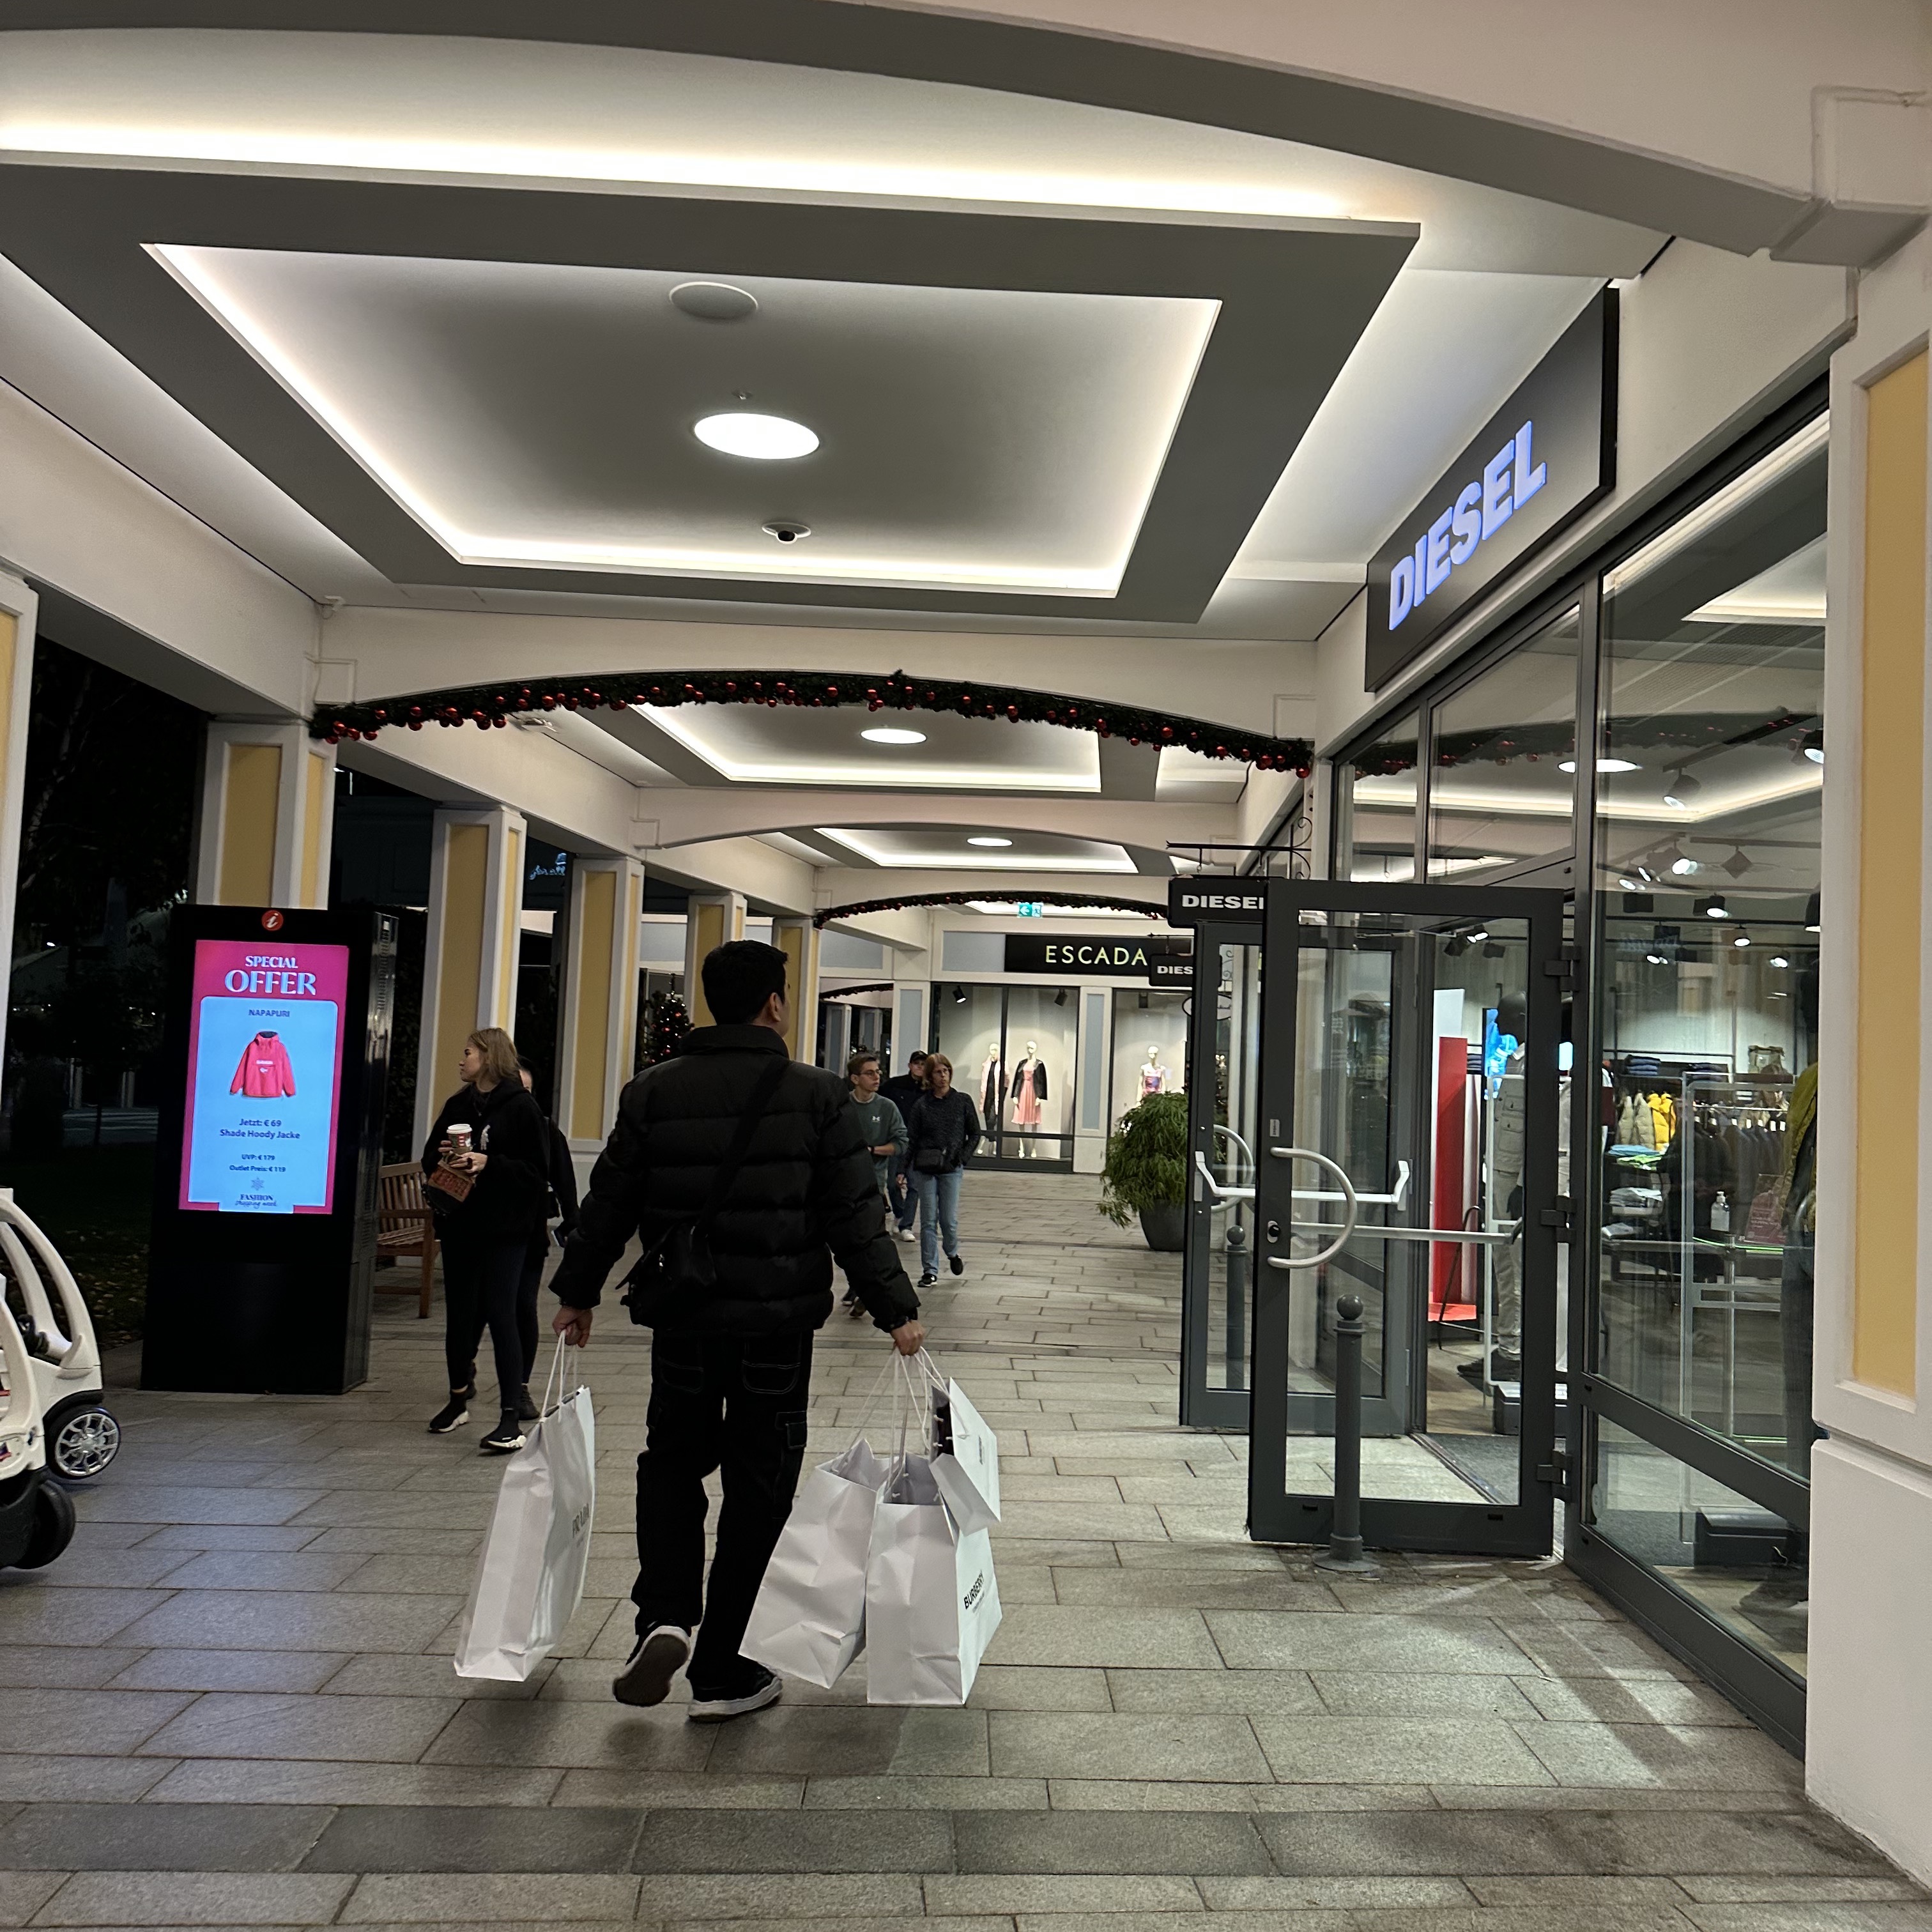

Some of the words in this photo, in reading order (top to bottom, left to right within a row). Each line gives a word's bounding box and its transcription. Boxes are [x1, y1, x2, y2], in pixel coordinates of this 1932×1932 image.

[1388, 420, 1547, 631] DIESEL
[245, 956, 298, 969] SPECIAL
[1045, 946, 1148, 966] ESCADA
[1157, 965, 1193, 975] DIES
[225, 969, 316, 995] OFFER
[220, 1129, 246, 1137] Shade
[247, 1130, 275, 1140] Hoody
